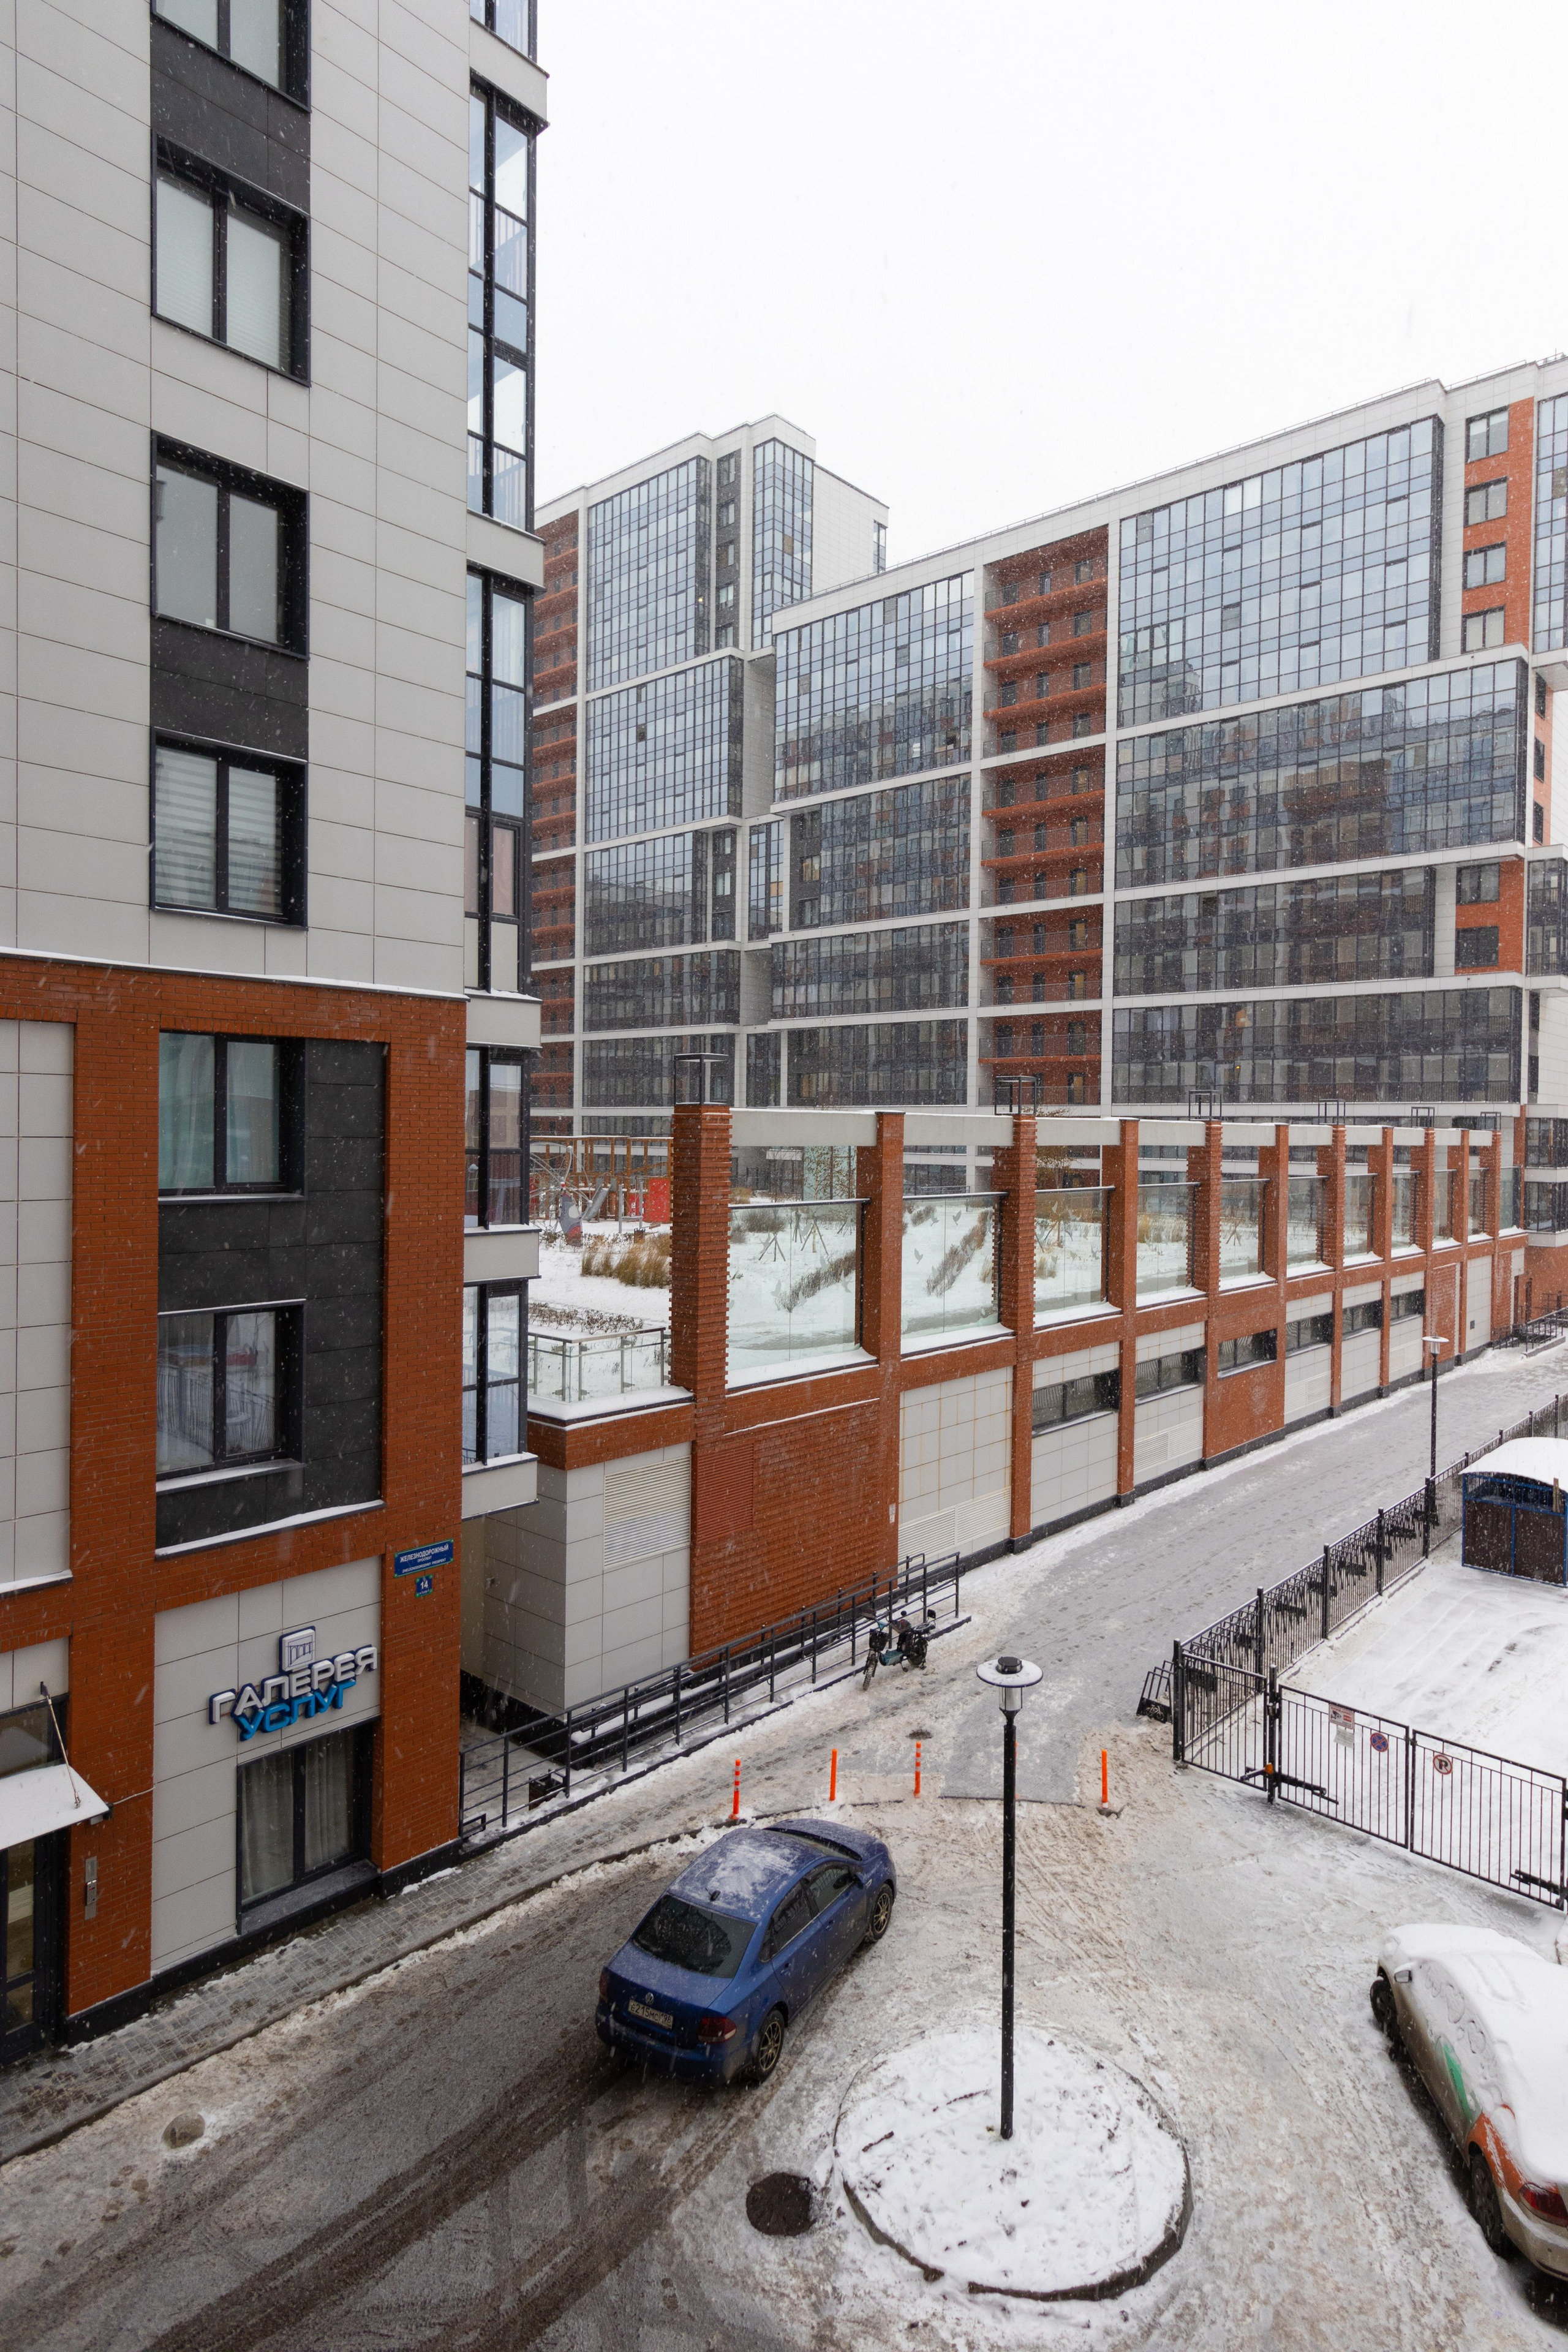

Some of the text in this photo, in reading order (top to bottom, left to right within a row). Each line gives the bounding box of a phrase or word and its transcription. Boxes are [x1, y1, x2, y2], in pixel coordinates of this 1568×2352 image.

[400, 1544, 449, 1562] ЖЕЛЕЗНОДОРОЖНЫЙ
[420, 1580, 429, 1589] 14
[209, 1644, 377, 1724] ГАЛЕРЕЯ
[233, 1678, 356, 1741] УСЛУГ
